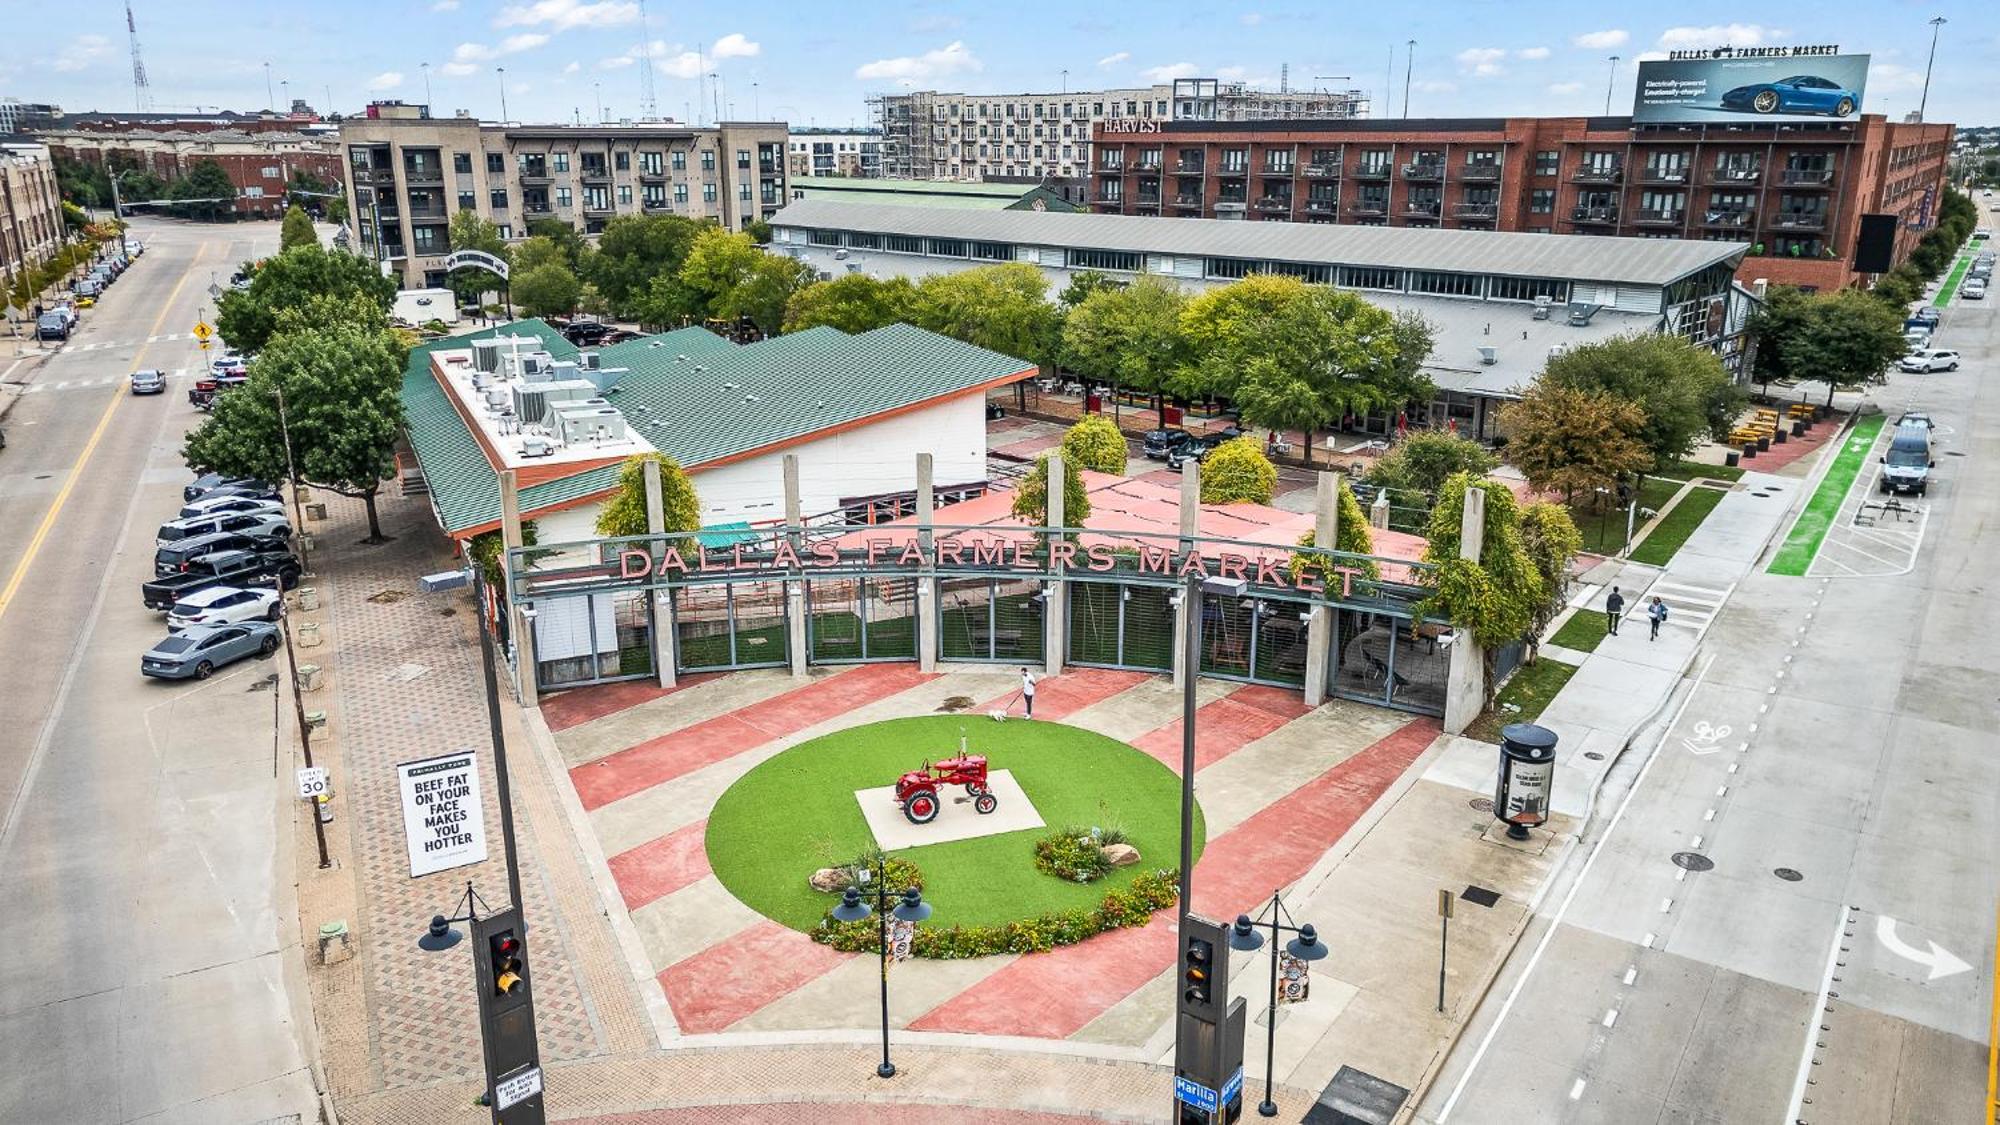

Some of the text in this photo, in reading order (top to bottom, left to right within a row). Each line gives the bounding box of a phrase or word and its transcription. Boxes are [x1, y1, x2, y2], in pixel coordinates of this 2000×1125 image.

[1670, 44, 1840, 60] DALLAS FARMERS MARKET
[1104, 119, 1163, 133] HARVEST
[619, 537, 1364, 597] DALLAS FARMERS MARKET
[302, 781, 324, 794] 30
[414, 773, 469, 794] BEEF FAT
[415, 785, 471, 806] ON YOUR
[430, 799, 459, 815] FACE
[425, 810, 468, 828] MAKES
[434, 823, 460, 838] YOU
[424, 832, 473, 852] HOTTER
[1177, 1079, 1215, 1102] Marilla
